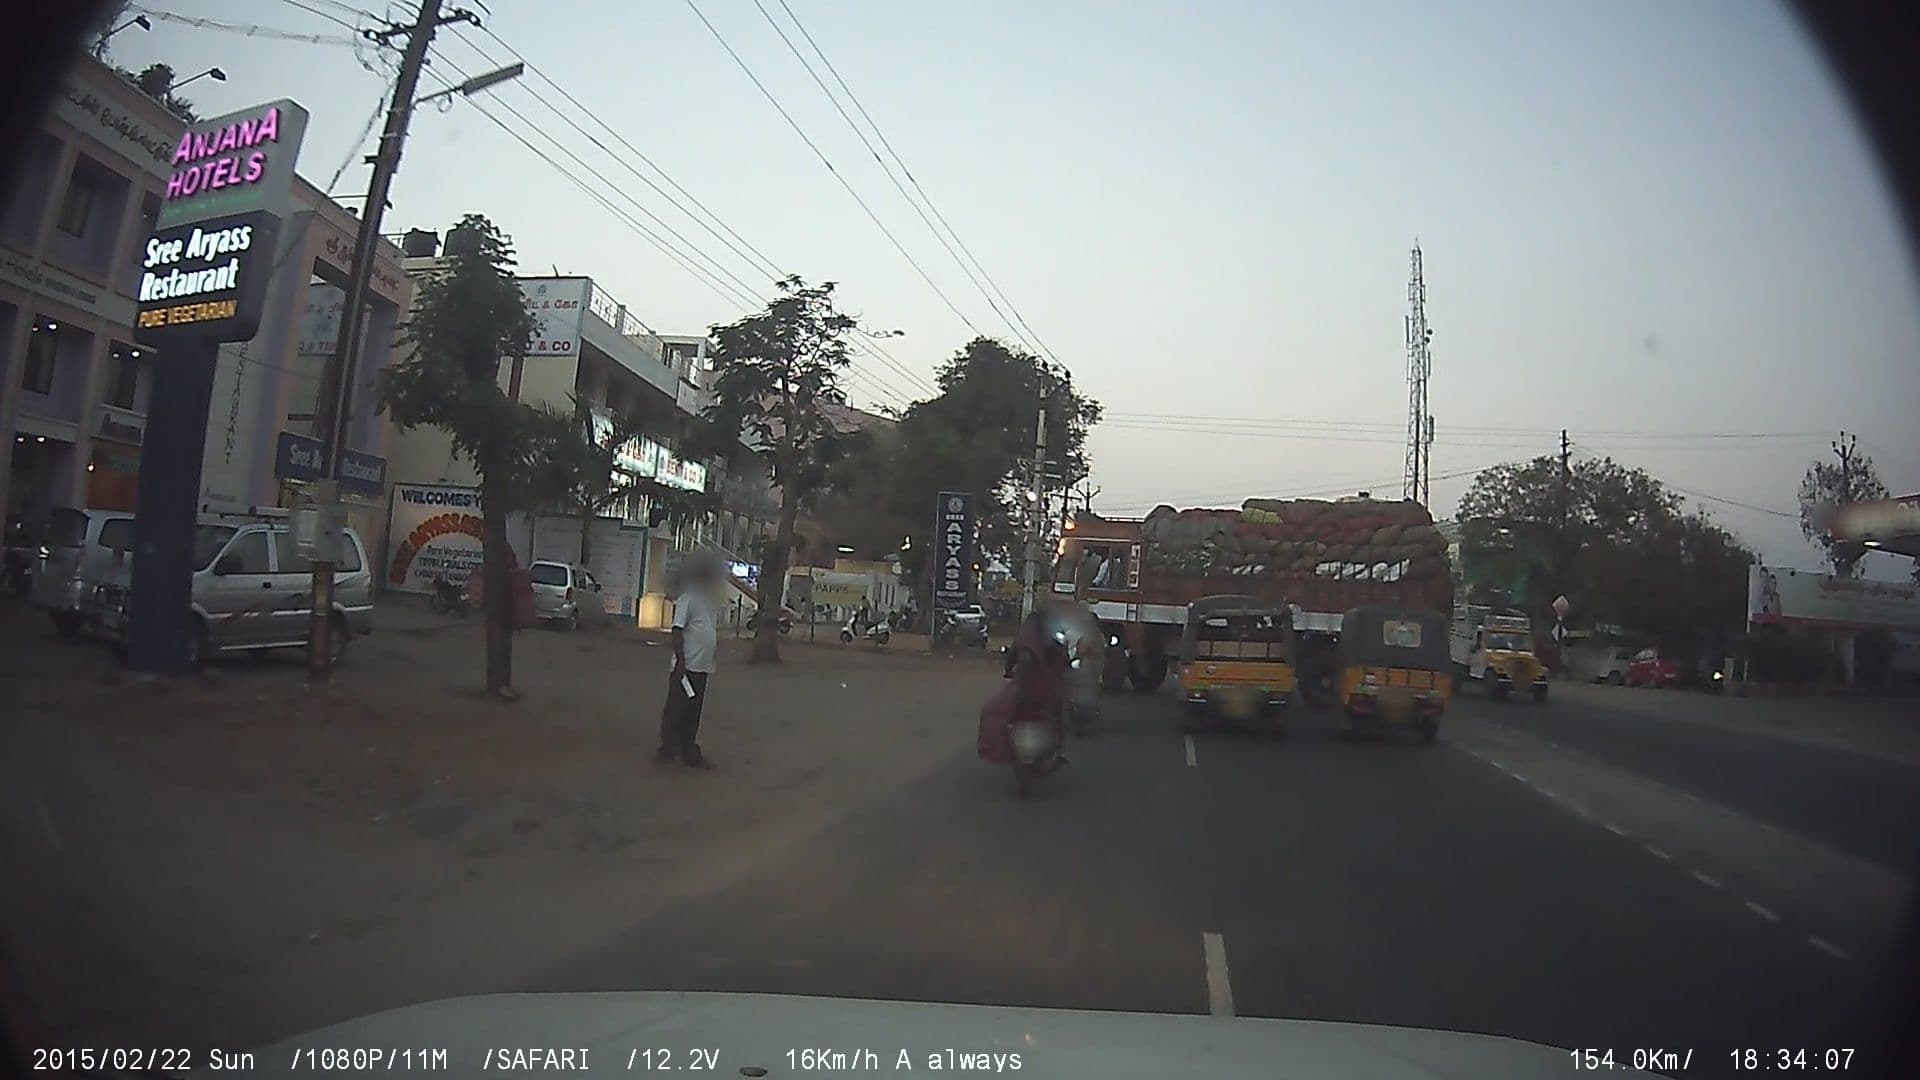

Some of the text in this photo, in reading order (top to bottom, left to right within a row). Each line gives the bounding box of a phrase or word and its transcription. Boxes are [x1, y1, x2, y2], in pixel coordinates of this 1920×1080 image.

[171, 106, 278, 165] ANJANA
[165, 151, 265, 199] HOTELS
[143, 225, 252, 268] Sree Aryass
[139, 257, 240, 301] Restaurant
[167, 299, 238, 324] VEGETARIAN
[538, 340, 548, 351] &
[551, 340, 571, 351] CO
[401, 489, 472, 507] WELCOMES
[945, 522, 963, 591] ARYASS
